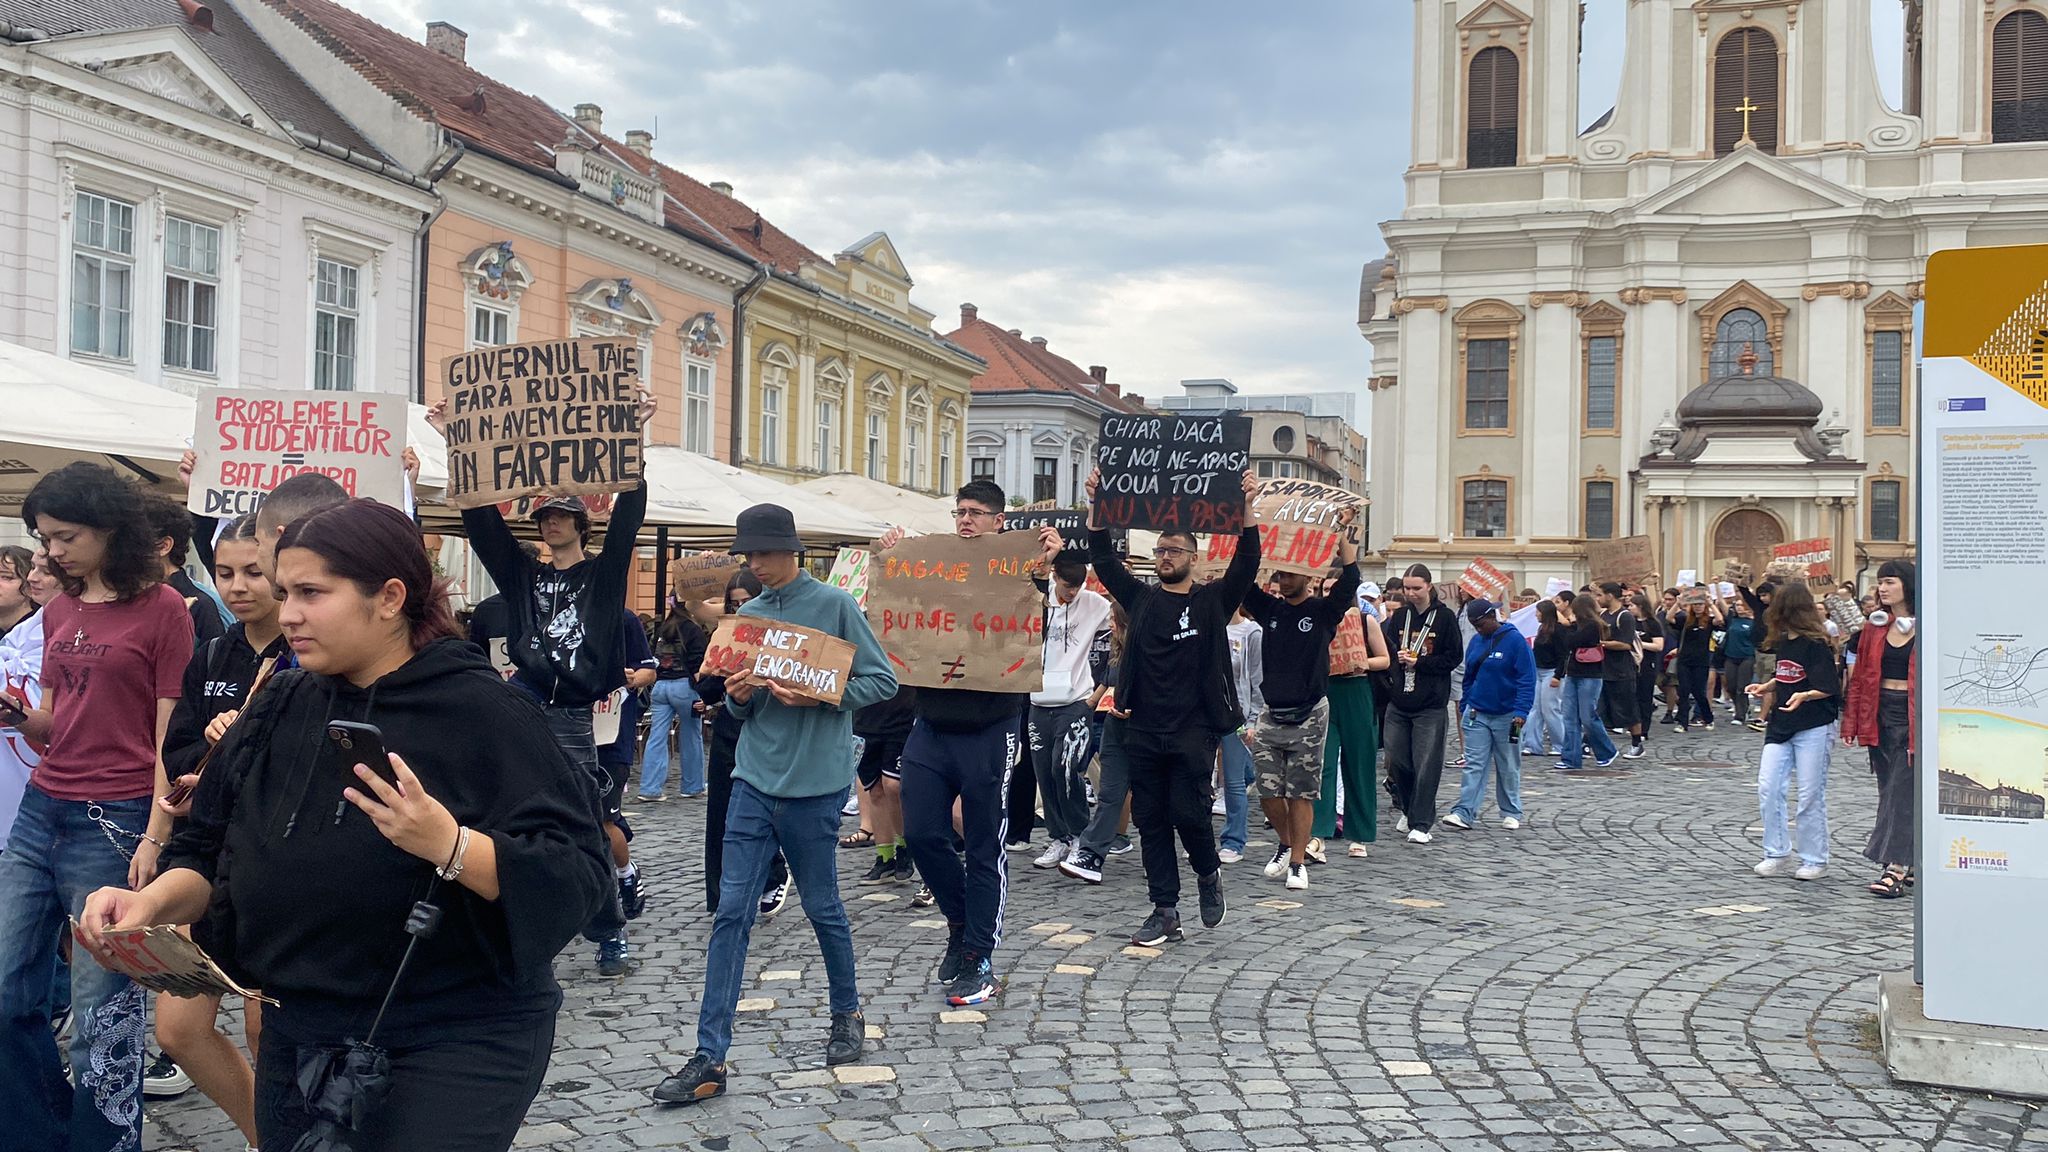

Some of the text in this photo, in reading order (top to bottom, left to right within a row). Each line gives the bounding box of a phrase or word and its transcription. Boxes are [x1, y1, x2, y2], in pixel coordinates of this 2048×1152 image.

[449, 342, 589, 387] GUVERNUL
[215, 397, 378, 429] PROBLEMELE
[446, 404, 640, 446] NOI N-AVEM CE PUNE
[1104, 417, 1223, 444] CHIAR DACĂ
[1100, 446, 1118, 467] PE
[1127, 444, 1162, 468] NOI
[450, 451, 478, 494] ÎN
[1101, 468, 1218, 495] VOUĂ TOT
[1097, 496, 1135, 527] NU
[1145, 496, 1181, 528] VĂ
[1286, 527, 1338, 568] NU
[885, 556, 971, 582] BAGAJE
[1005, 732, 1016, 770] SPORT
[1959, 856, 2008, 869] HERITAGE
